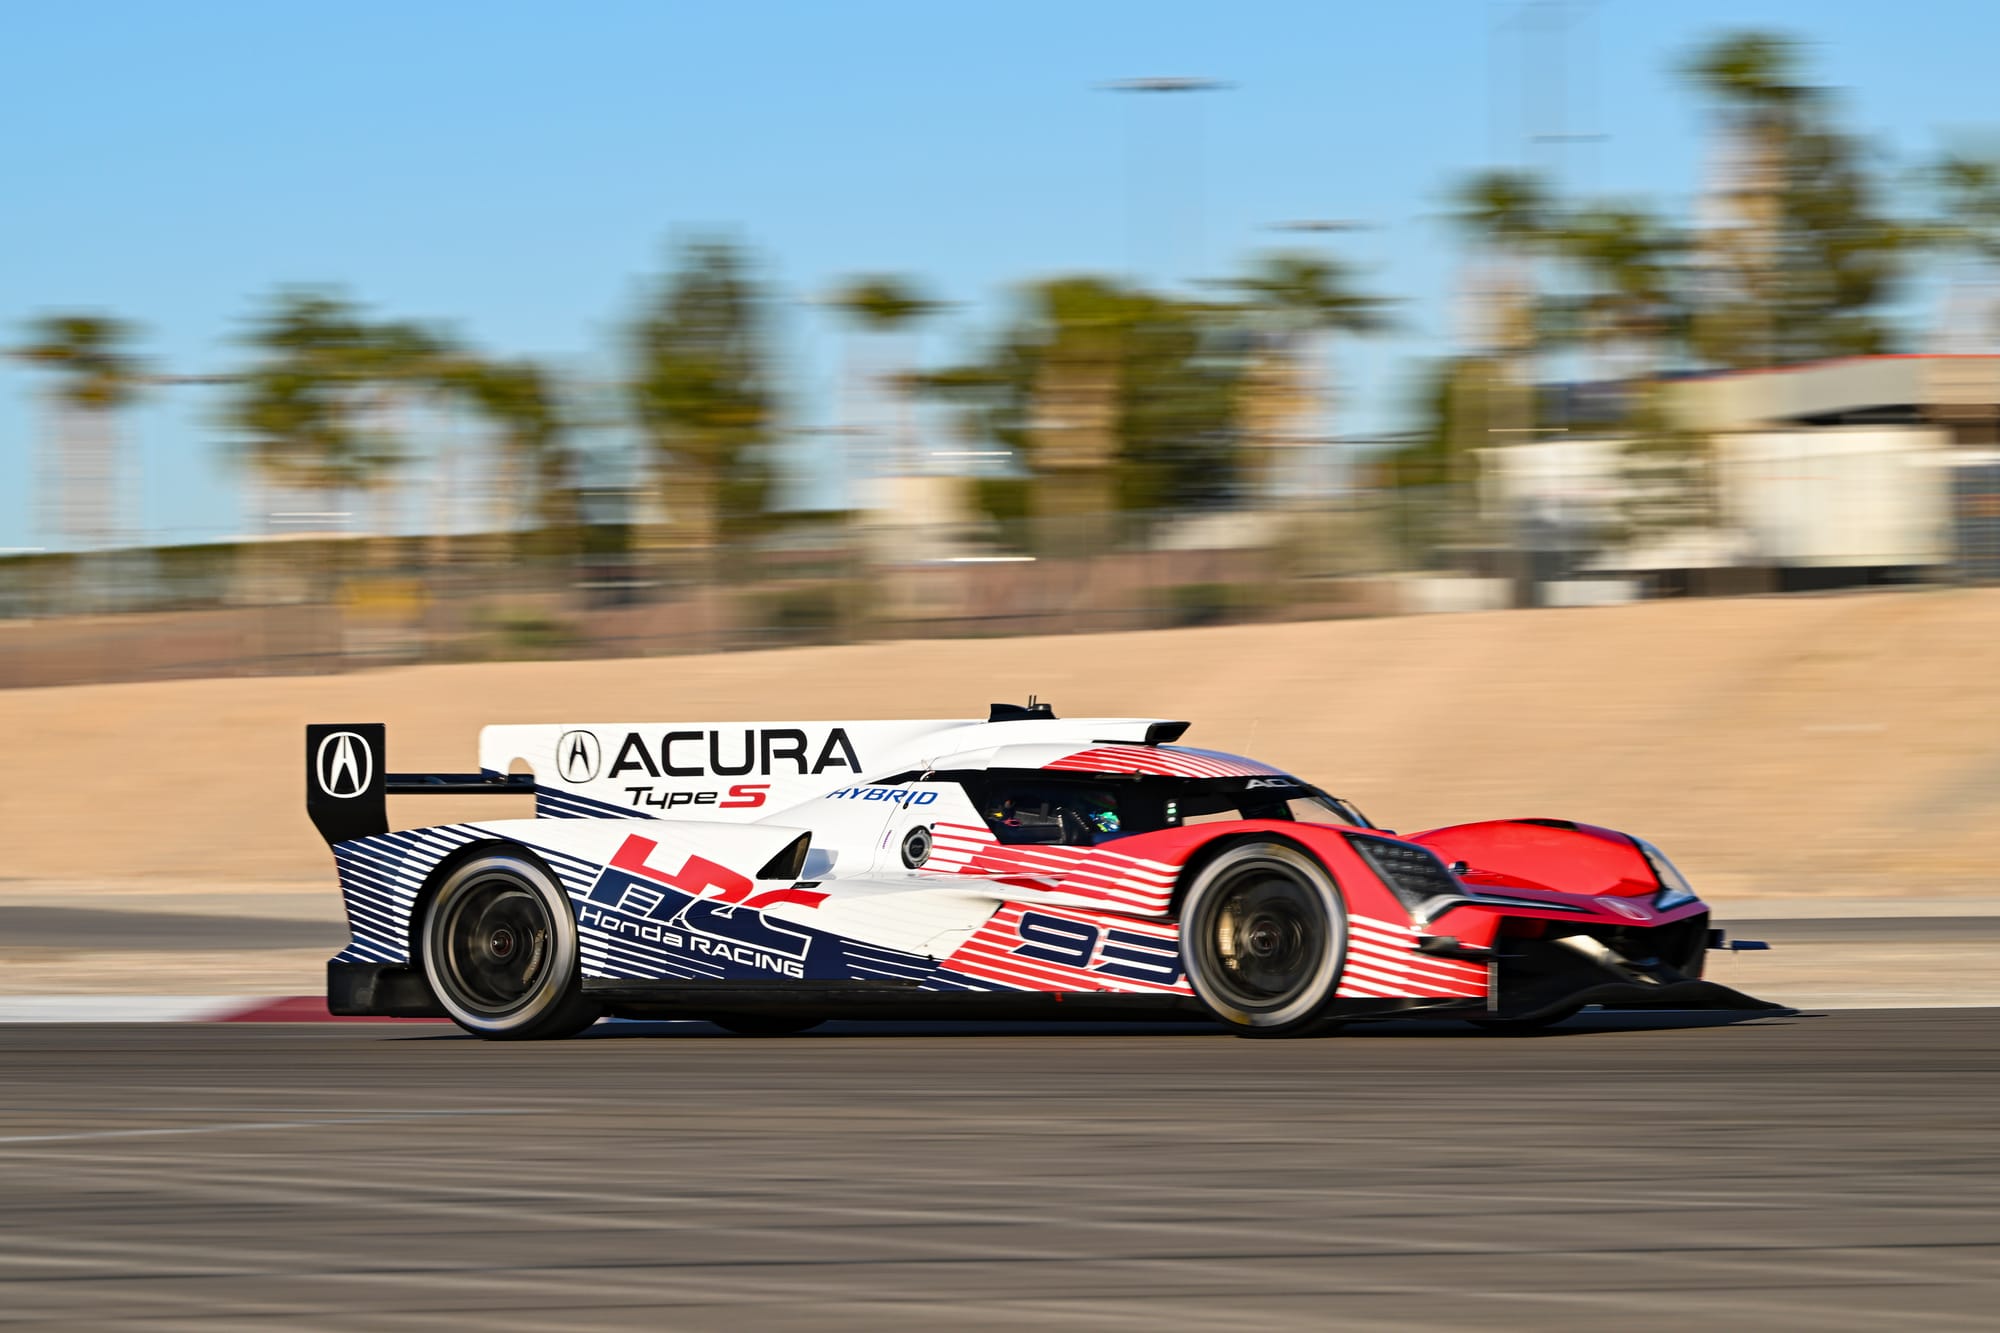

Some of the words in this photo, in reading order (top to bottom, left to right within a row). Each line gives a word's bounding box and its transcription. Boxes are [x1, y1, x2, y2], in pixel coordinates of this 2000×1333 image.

[608, 728, 863, 778] ACURA
[624, 786, 718, 809] Type
[719, 784, 771, 808] S
[826, 788, 939, 805] HYBRID
[579, 906, 682, 947] Honda
[690, 936, 804, 978] RACING
[1012, 911, 1185, 985] 93
